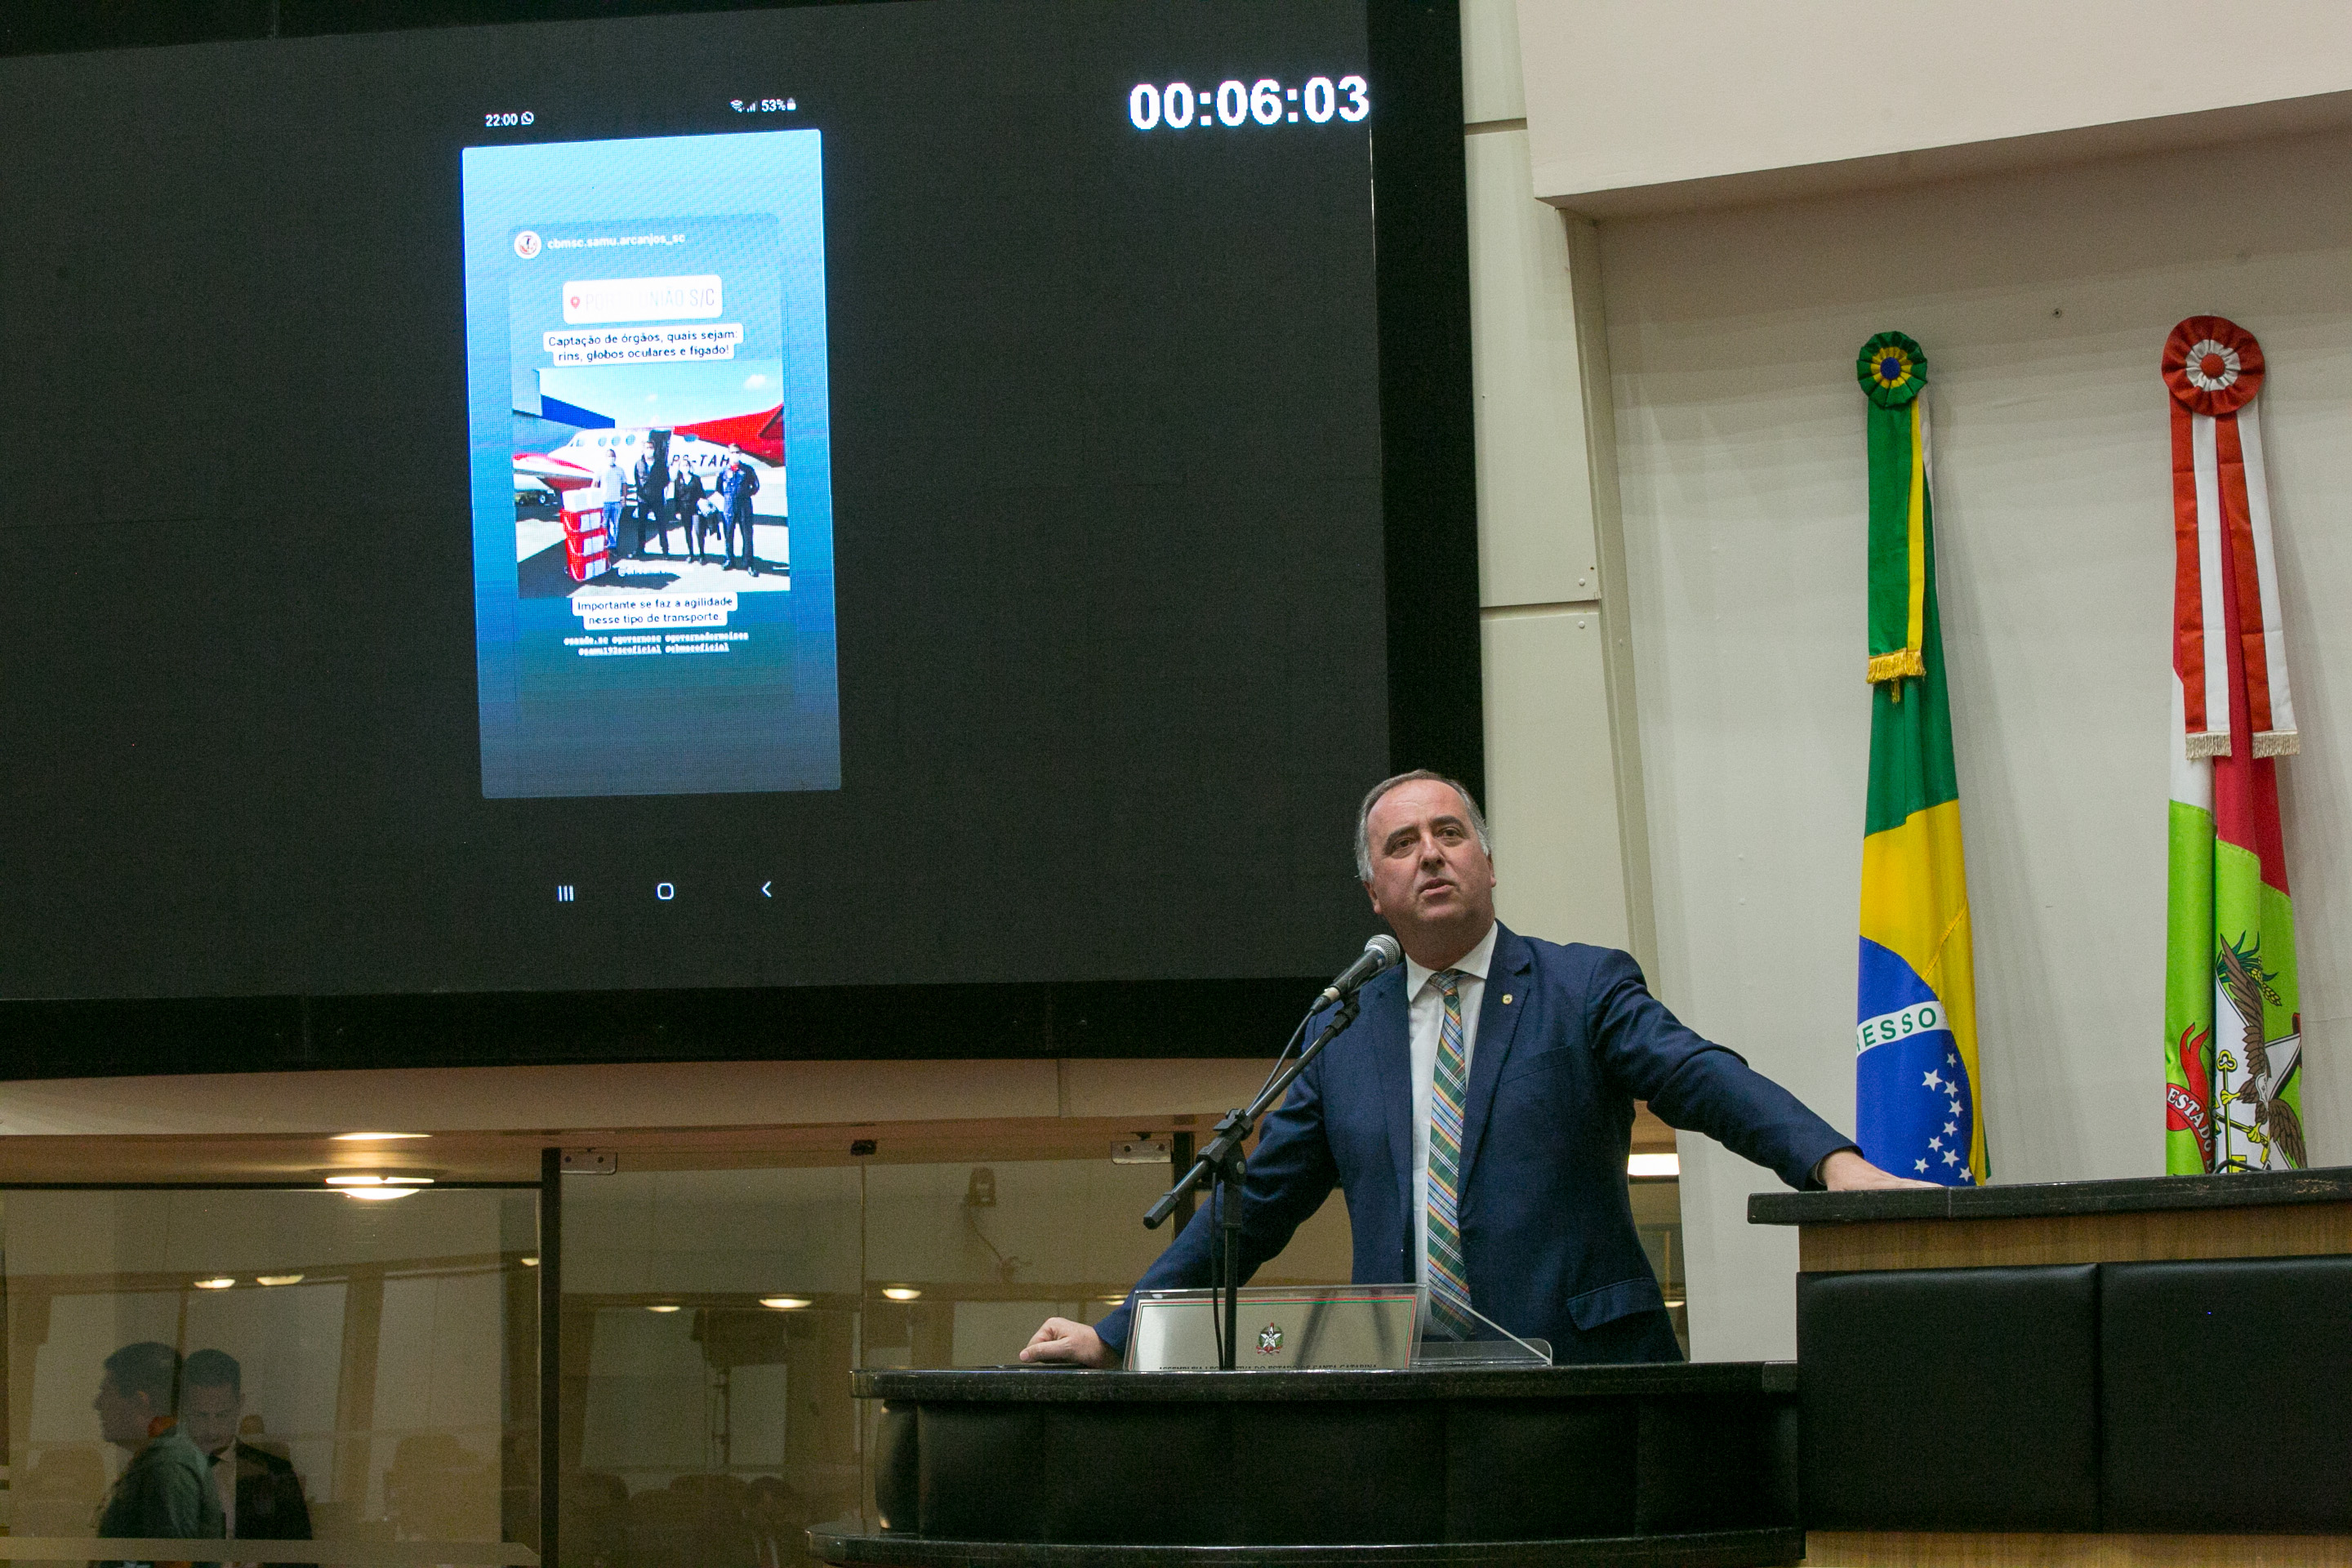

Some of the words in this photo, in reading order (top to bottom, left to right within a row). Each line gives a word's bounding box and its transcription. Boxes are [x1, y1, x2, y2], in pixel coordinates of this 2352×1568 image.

[761, 99, 786, 113] 53%
[1129, 75, 1370, 130] 00:06:03
[485, 113, 519, 127] 22:00
[689, 288, 715, 307] S/C
[549, 335, 601, 348] Captação
[604, 334, 617, 344] de
[667, 330, 697, 343] quais
[559, 351, 582, 362] rins,
[586, 350, 624, 363] globos
[628, 347, 676, 358] oculares
[679, 348, 686, 356] e
[577, 602, 636, 612] Importante
[655, 599, 671, 608] faz
[684, 597, 733, 609] agilidade
[623, 615, 644, 626] tipo
[647, 614, 660, 622] de
[2167, 1087, 2212, 1152] ESTADO
